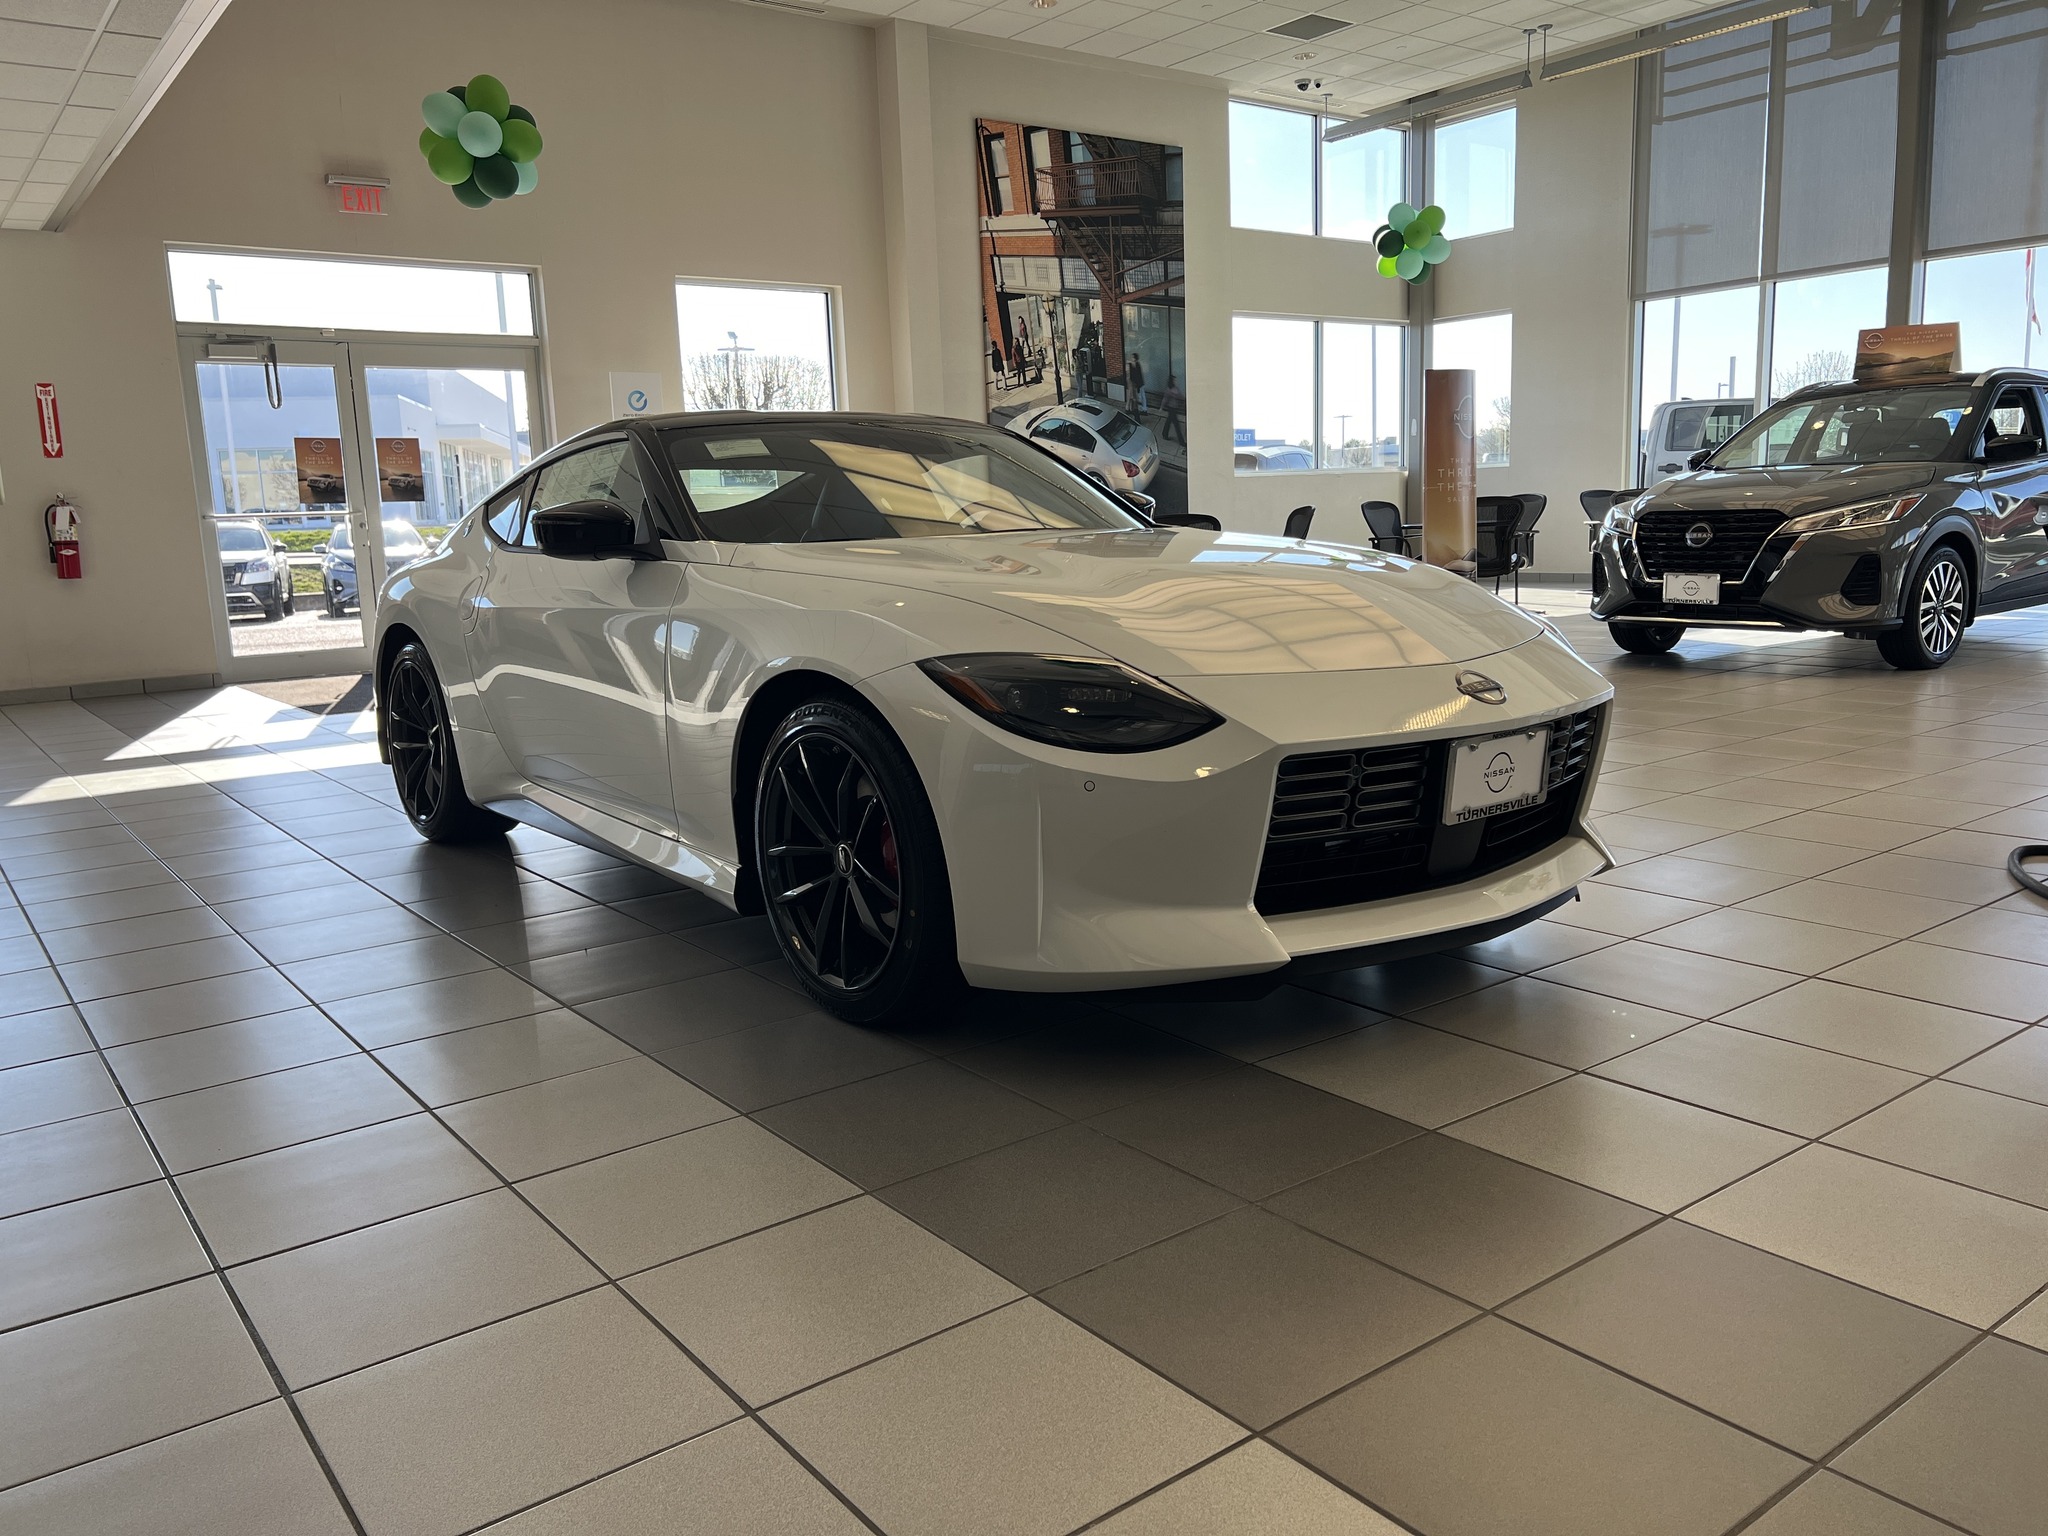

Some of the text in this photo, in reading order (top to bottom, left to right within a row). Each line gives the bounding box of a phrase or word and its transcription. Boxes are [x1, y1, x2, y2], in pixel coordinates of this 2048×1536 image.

[342, 186, 382, 213] EXIT
[1454, 413, 1473, 421] NISS
[1437, 482, 1462, 491] THE
[1483, 766, 1516, 779] NISSAN
[1456, 795, 1538, 823] TURNERSVILLE
